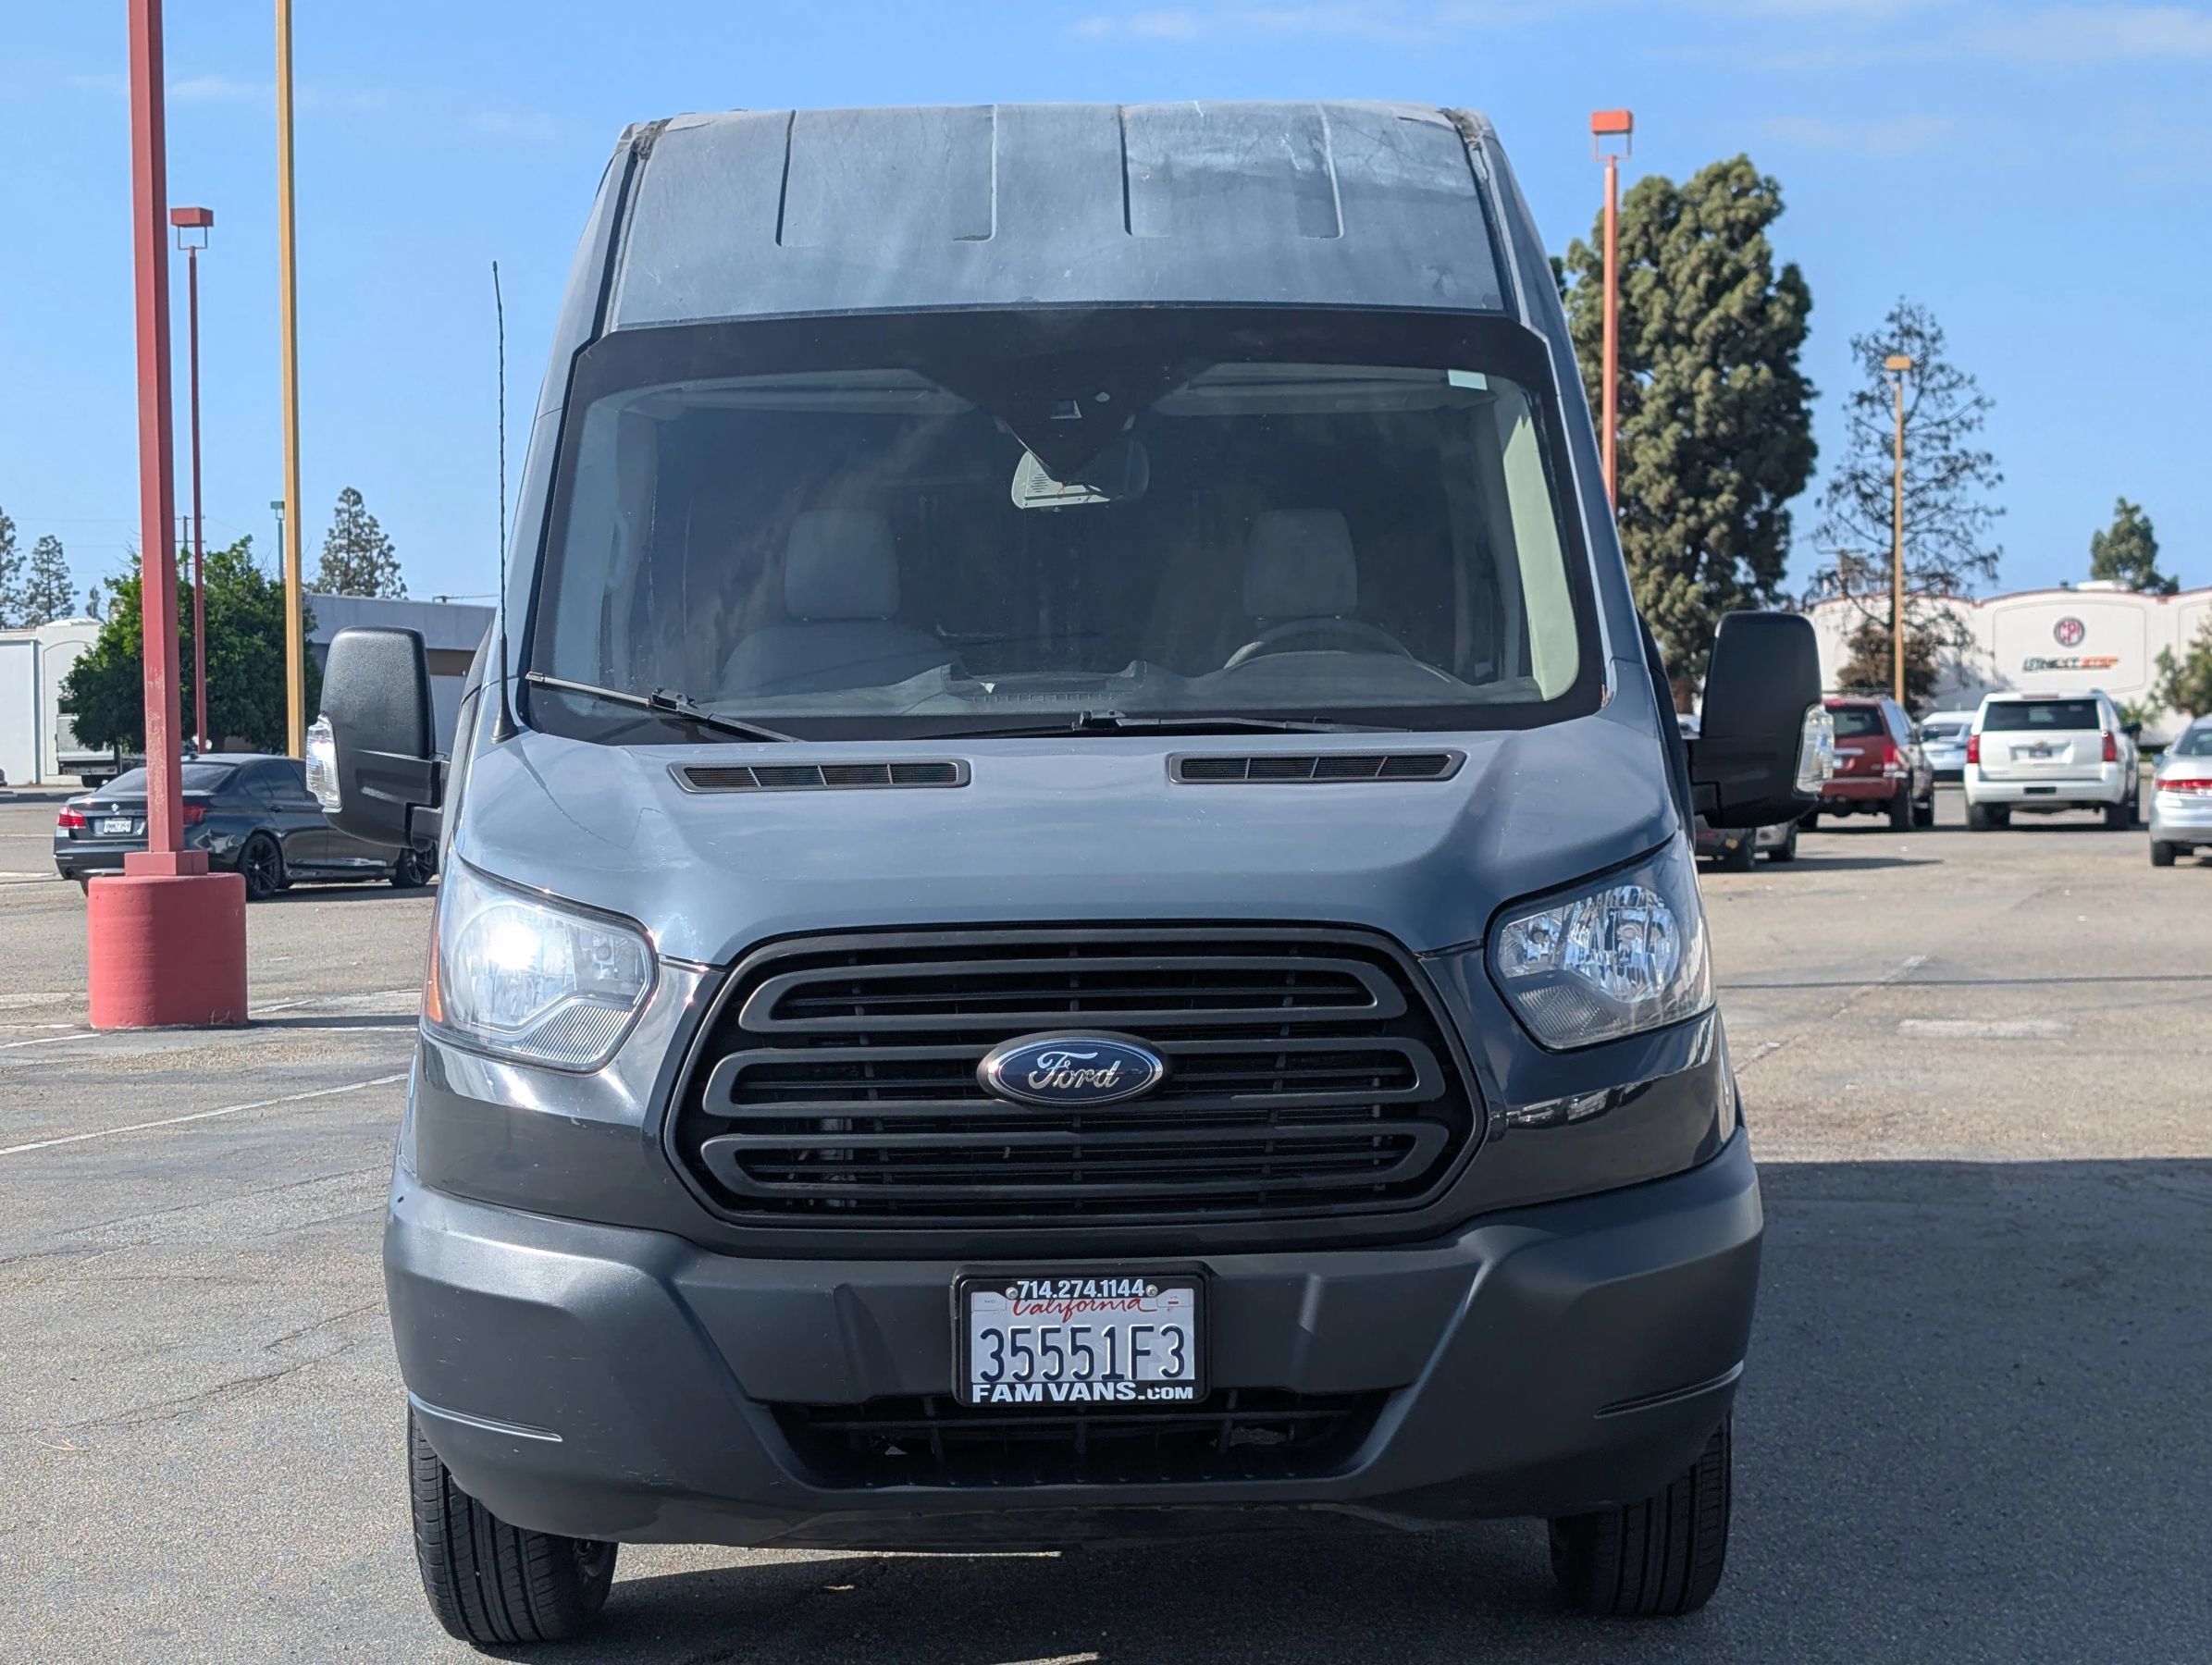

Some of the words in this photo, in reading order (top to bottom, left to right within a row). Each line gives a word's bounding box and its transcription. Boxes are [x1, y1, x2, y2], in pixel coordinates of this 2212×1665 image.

[1028, 1051, 1121, 1090] Ford
[1017, 1278, 1145, 1299] 714.274.1144
[1012, 1297, 1157, 1324] California
[980, 1324, 1185, 1382] 35551F3
